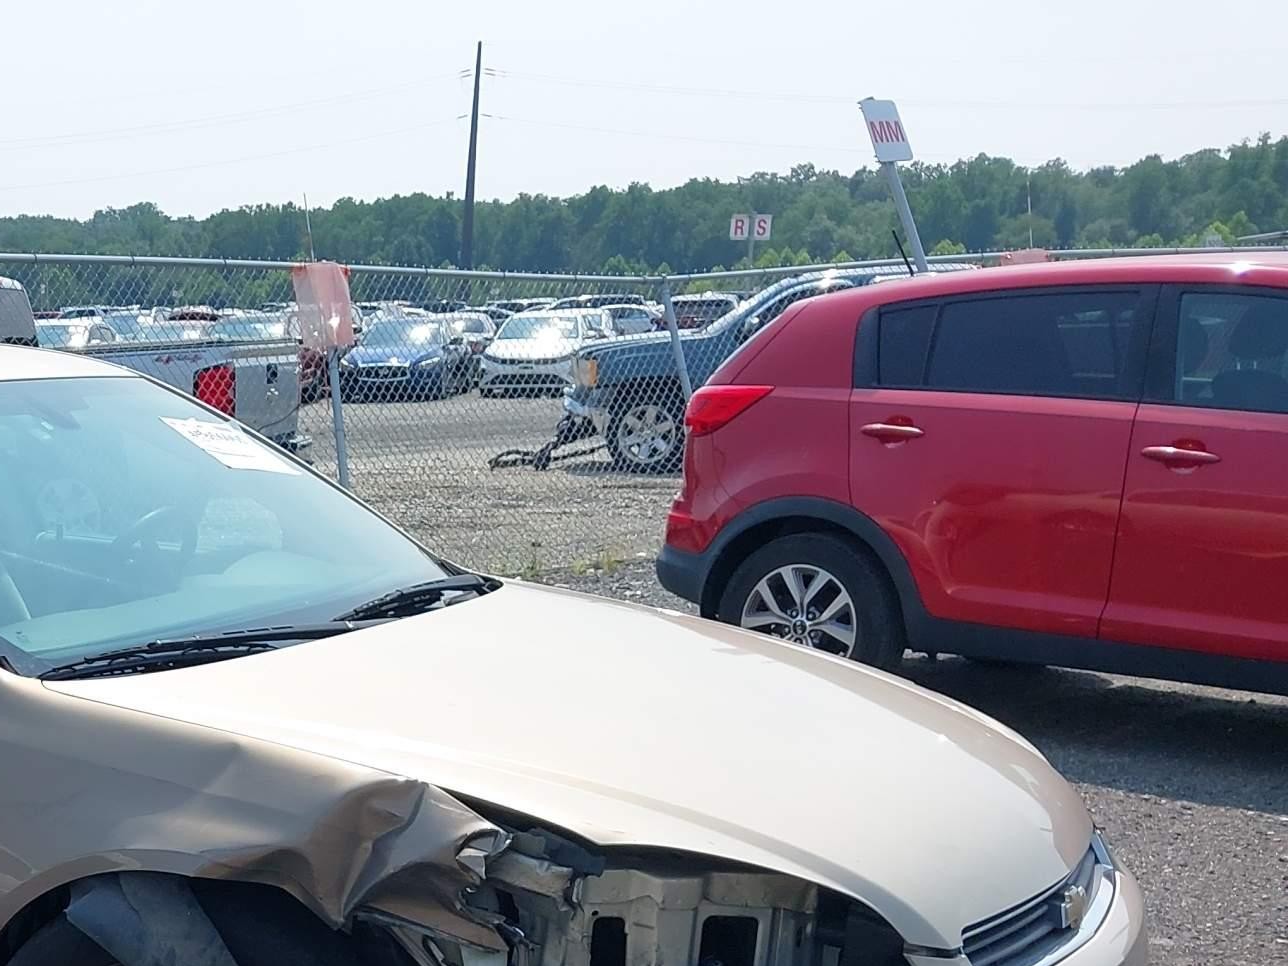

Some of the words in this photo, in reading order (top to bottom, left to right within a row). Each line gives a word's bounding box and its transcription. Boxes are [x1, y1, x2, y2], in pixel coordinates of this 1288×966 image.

[869, 120, 905, 143] MM
[734, 219, 745, 236] R
[757, 218, 768, 236] S
